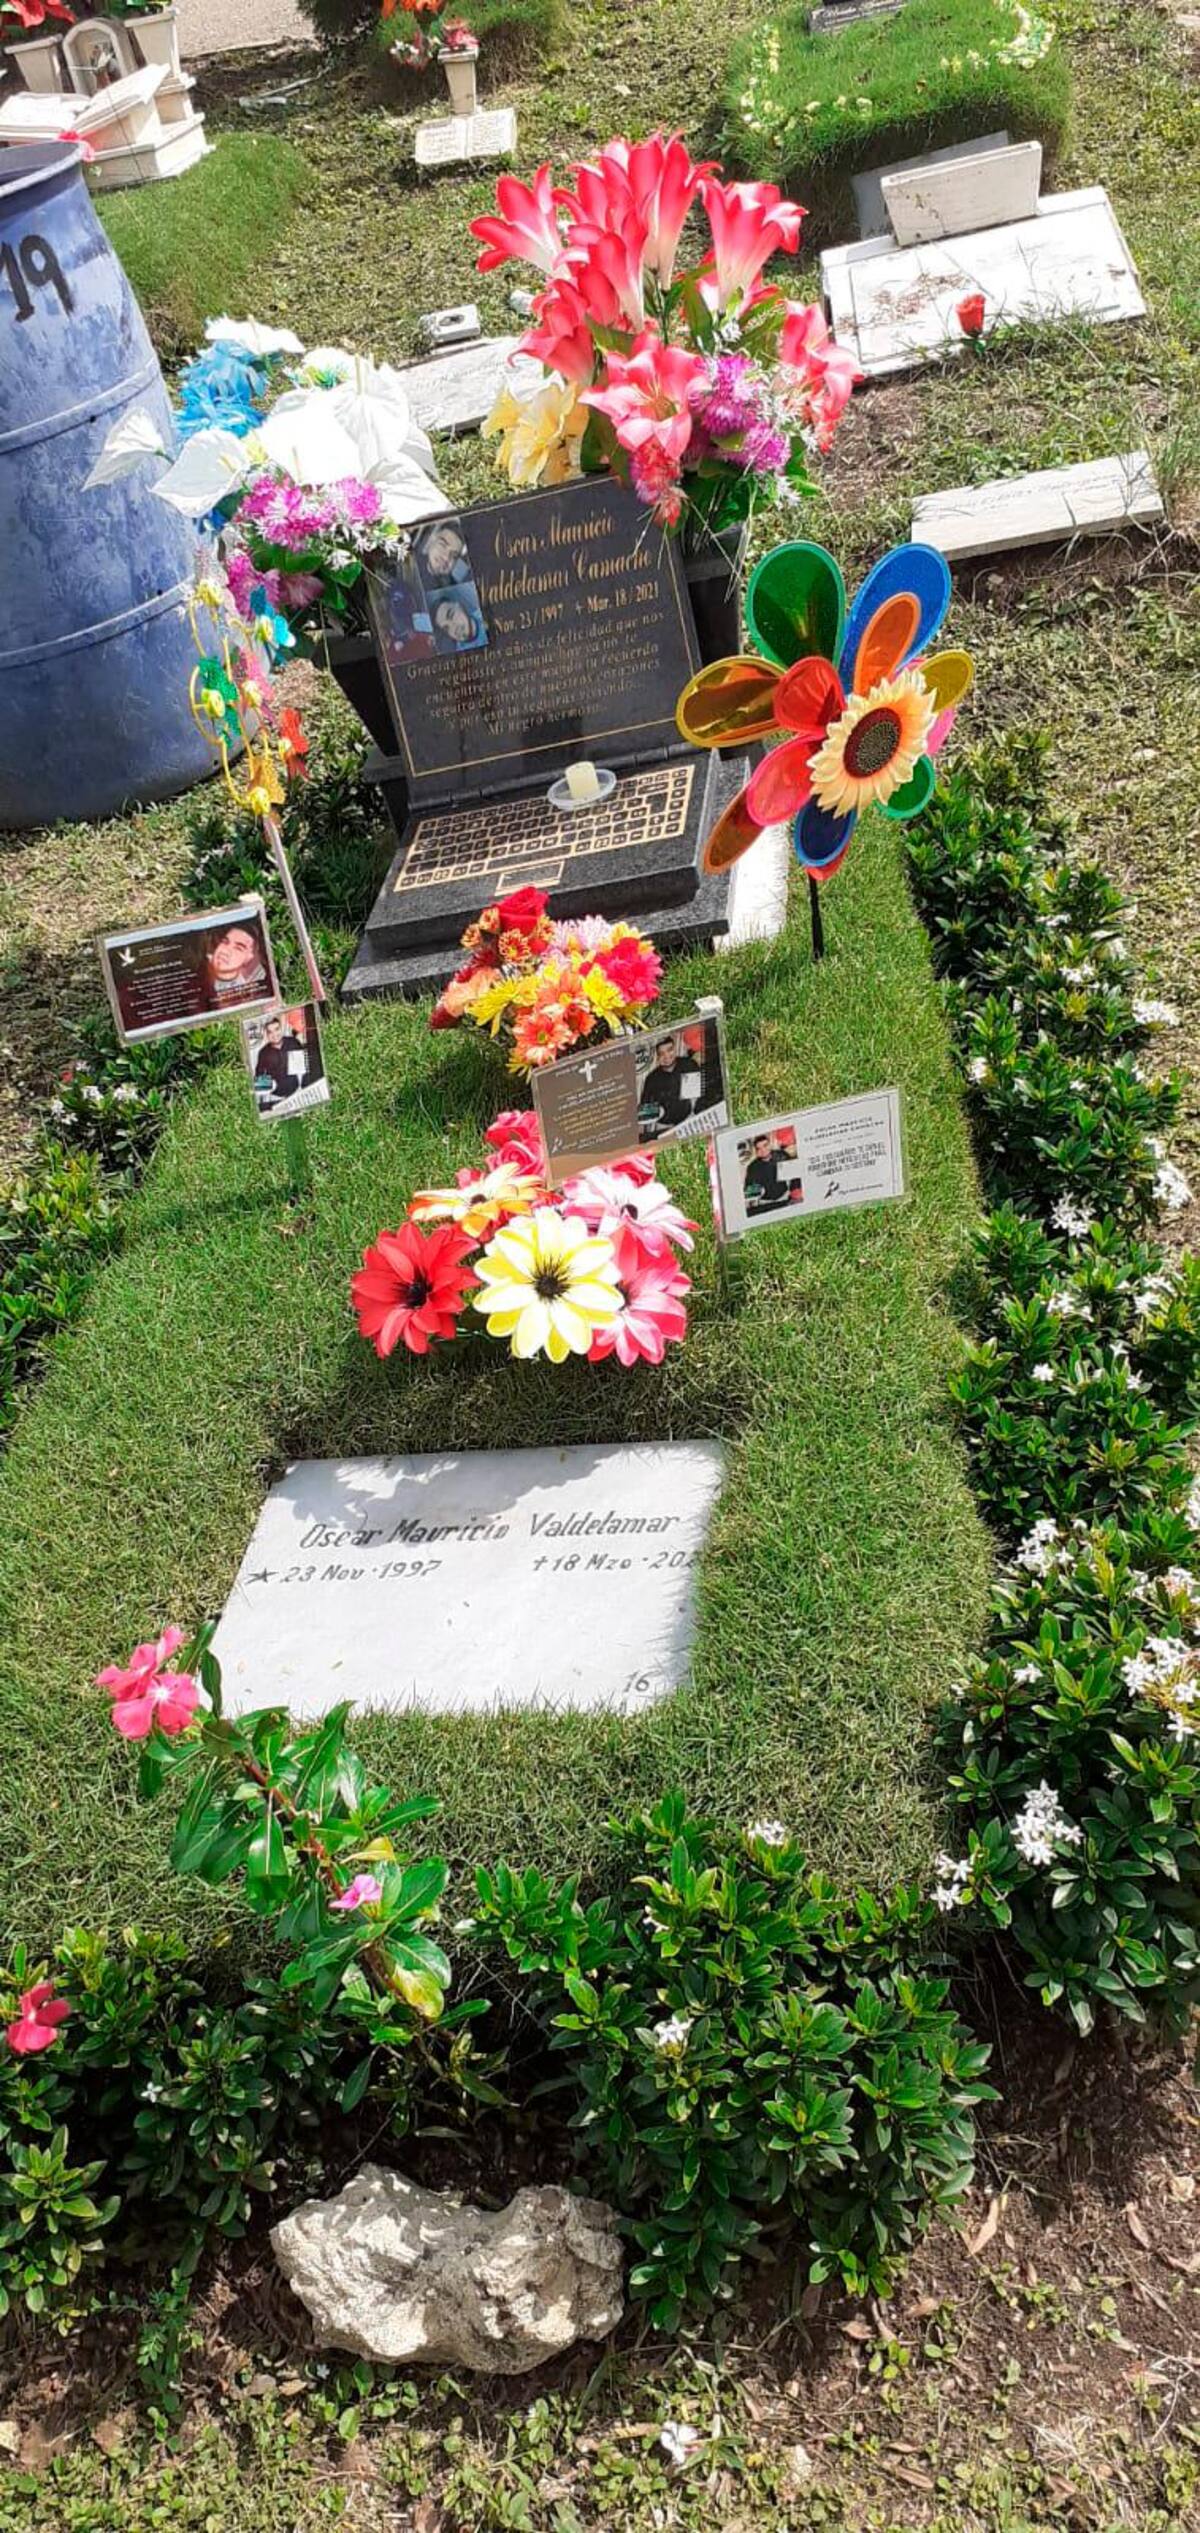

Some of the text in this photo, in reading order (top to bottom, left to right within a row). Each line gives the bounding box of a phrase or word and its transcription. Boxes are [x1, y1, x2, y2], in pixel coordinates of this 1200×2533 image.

[0, 234, 74, 322] 19
[494, 517, 537, 558] Oscar
[300, 1510, 680, 1549] Oscar Mauricio Valdelamar
